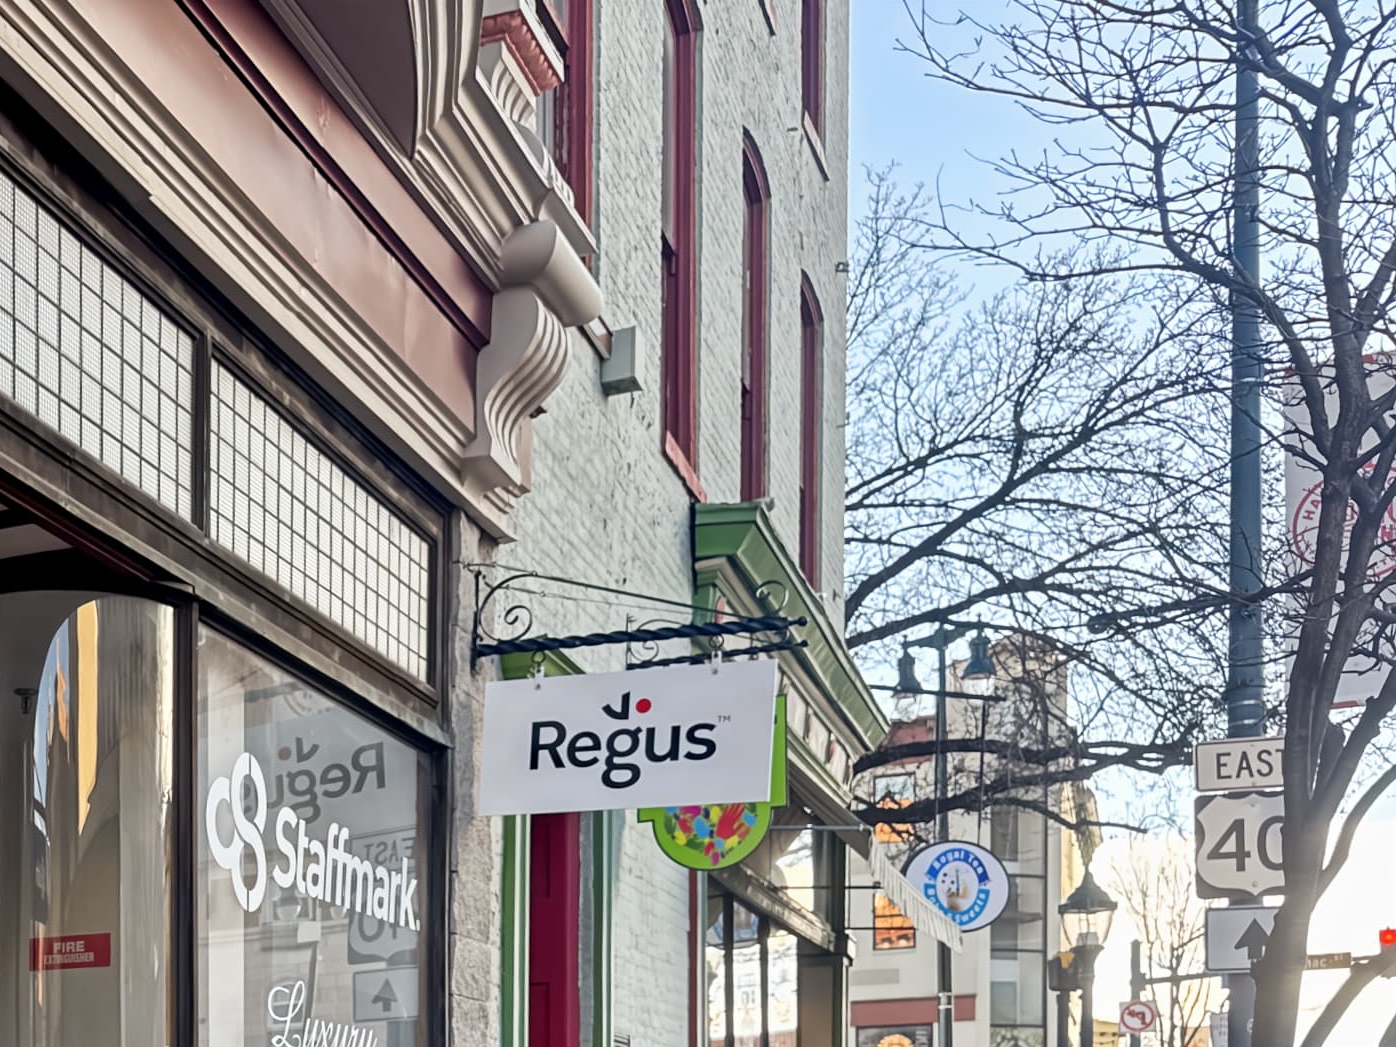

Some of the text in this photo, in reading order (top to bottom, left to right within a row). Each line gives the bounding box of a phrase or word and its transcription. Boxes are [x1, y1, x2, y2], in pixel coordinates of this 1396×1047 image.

[530, 718, 716, 789] Regus
[1216, 749, 1285, 780] EAS
[1206, 815, 1285, 872] 40
[53, 941, 85, 953] FIRE
